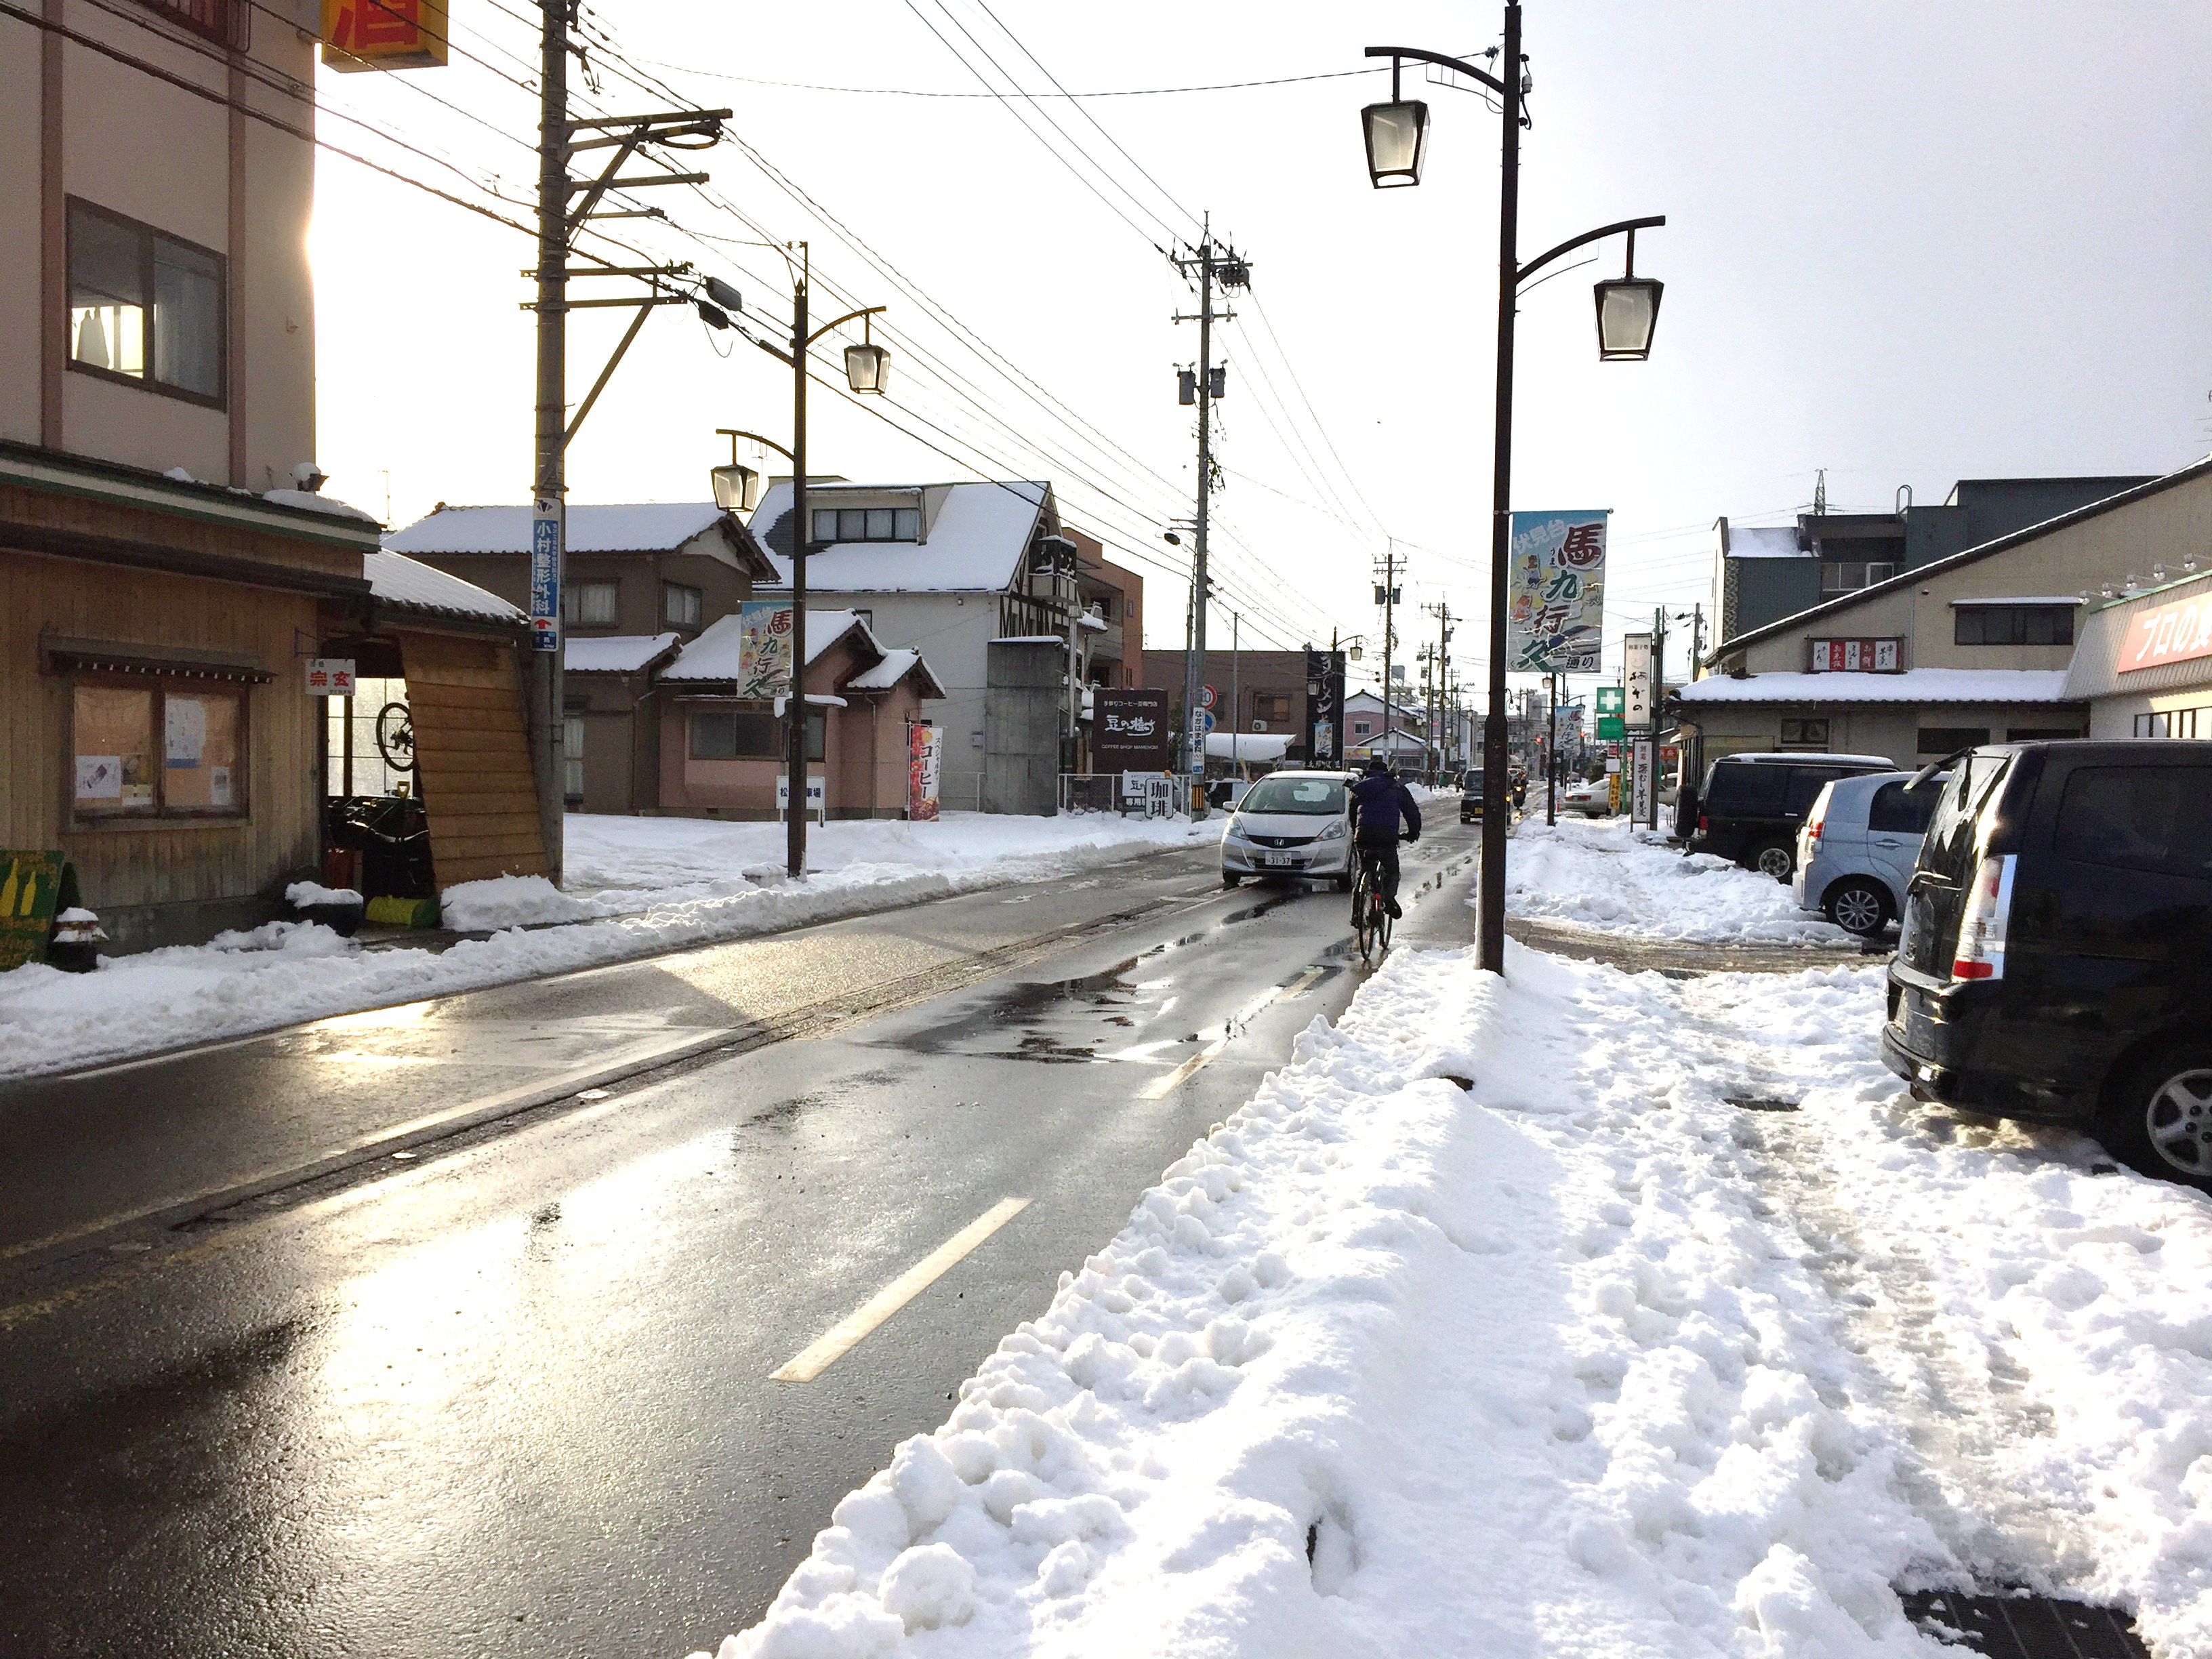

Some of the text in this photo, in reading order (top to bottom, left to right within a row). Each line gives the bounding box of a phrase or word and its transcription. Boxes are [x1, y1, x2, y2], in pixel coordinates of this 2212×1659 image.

[310, 670, 351, 687] 宗玄
[920, 745, 933, 799] コーヒー
[780, 787, 821, 798] 松車場
[1151, 781, 1168, 816] 珈琲
